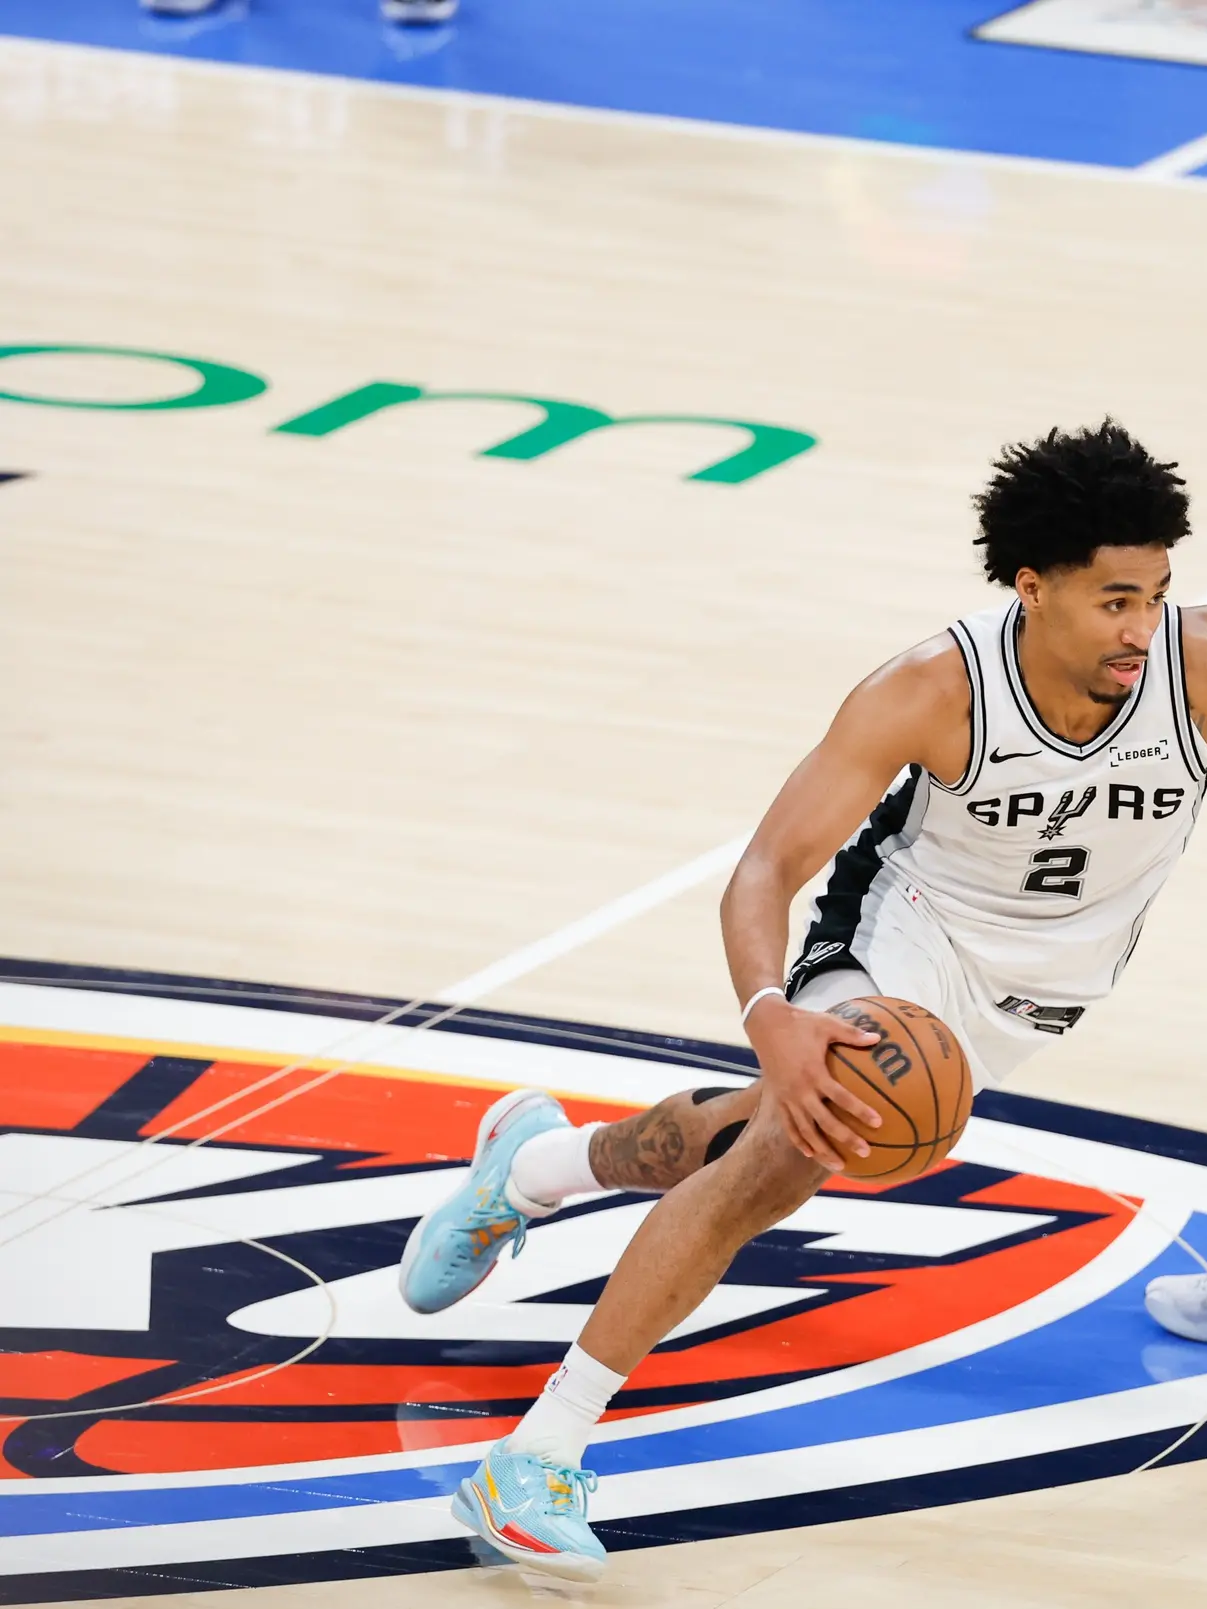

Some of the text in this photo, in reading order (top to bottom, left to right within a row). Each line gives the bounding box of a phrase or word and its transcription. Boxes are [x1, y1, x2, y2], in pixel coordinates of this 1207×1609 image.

[1117, 746, 1161, 761] LEDGER
[967, 784, 1185, 841] SPURS
[1020, 845, 1091, 900] 2
